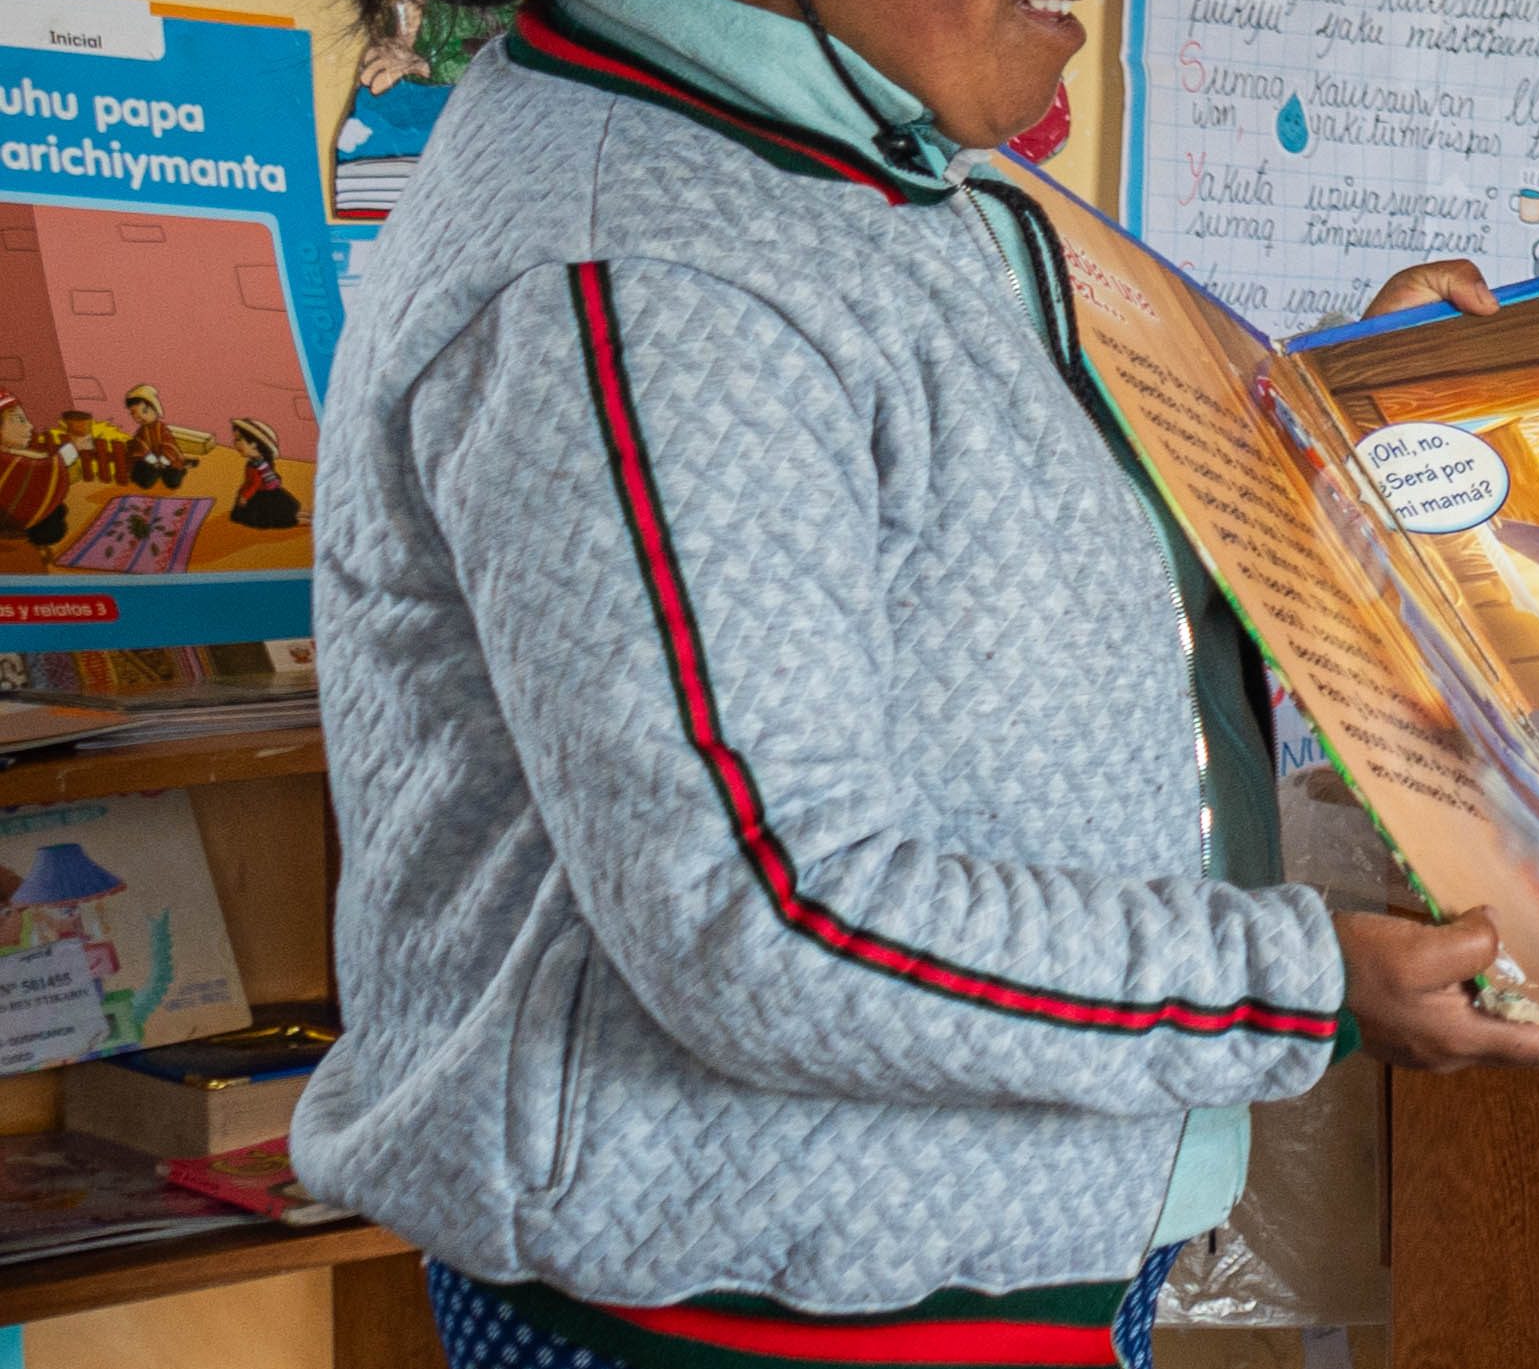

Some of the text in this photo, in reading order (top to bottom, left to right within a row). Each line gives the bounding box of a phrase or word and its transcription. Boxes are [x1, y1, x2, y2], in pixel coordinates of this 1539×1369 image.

[50, 30, 104, 50] Inicial
[94, 95, 205, 139] papa
[0, 134, 287, 193] arichiymanta
[1369, 435, 1450, 470] ¡Oh!, no.
[1376, 454, 1476, 499] ¿Será por
[1417, 479, 1494, 515] mamá?
